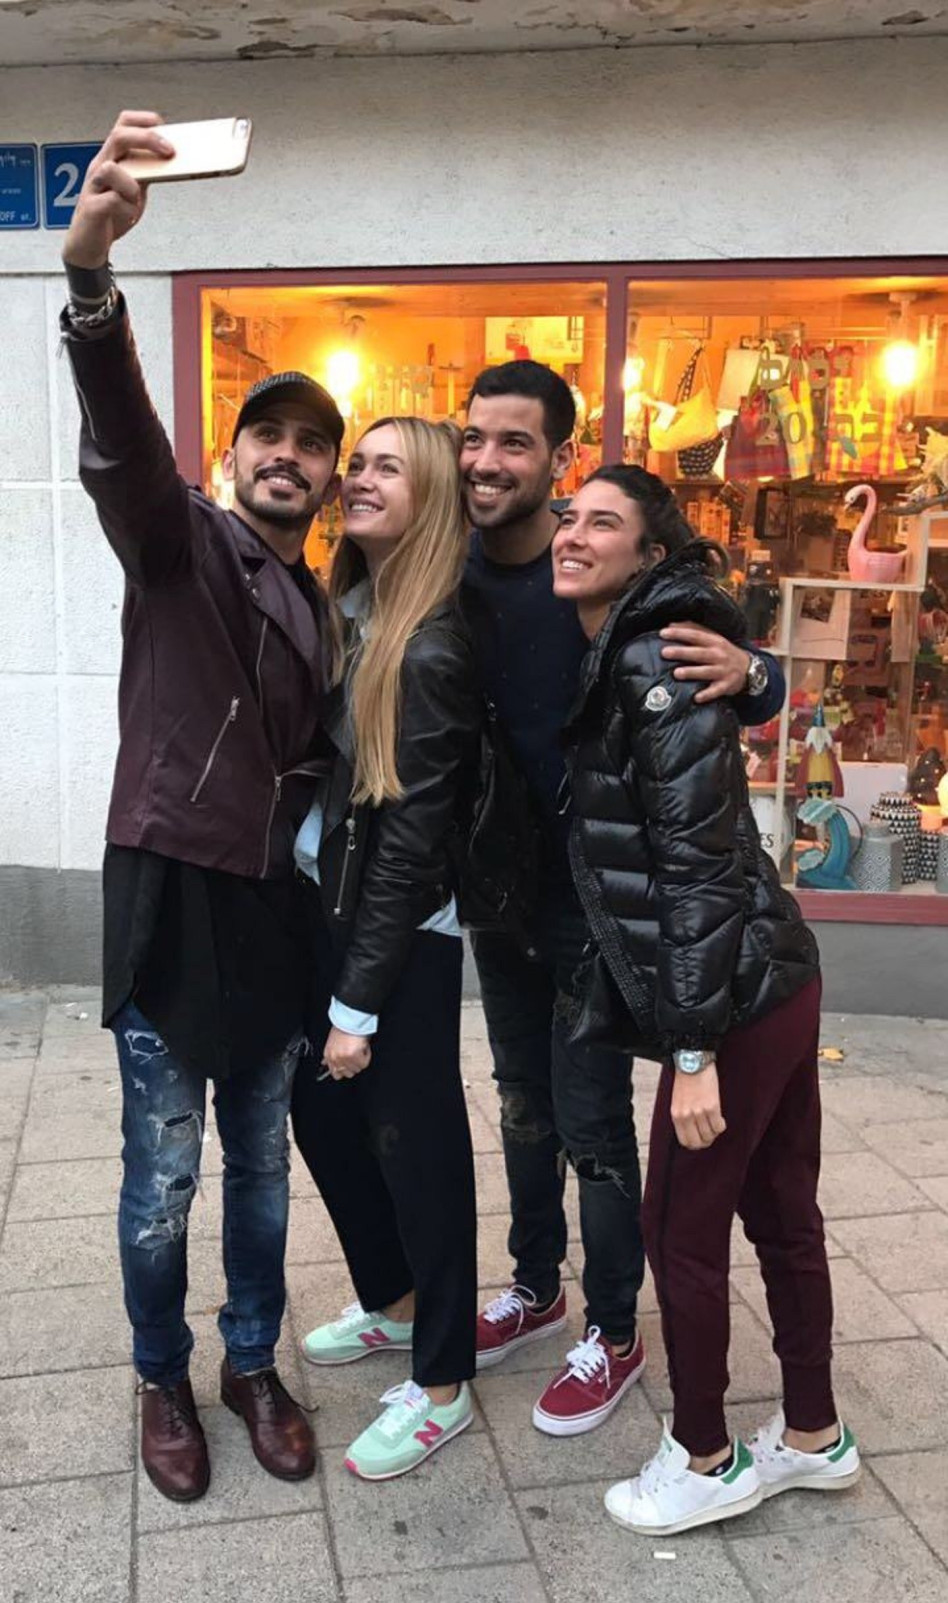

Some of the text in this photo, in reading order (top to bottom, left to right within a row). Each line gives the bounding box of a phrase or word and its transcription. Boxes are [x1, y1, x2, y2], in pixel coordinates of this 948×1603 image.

[54, 162, 80, 207] 2
[357, 1326, 391, 1348] N
[413, 1418, 444, 1448] N
